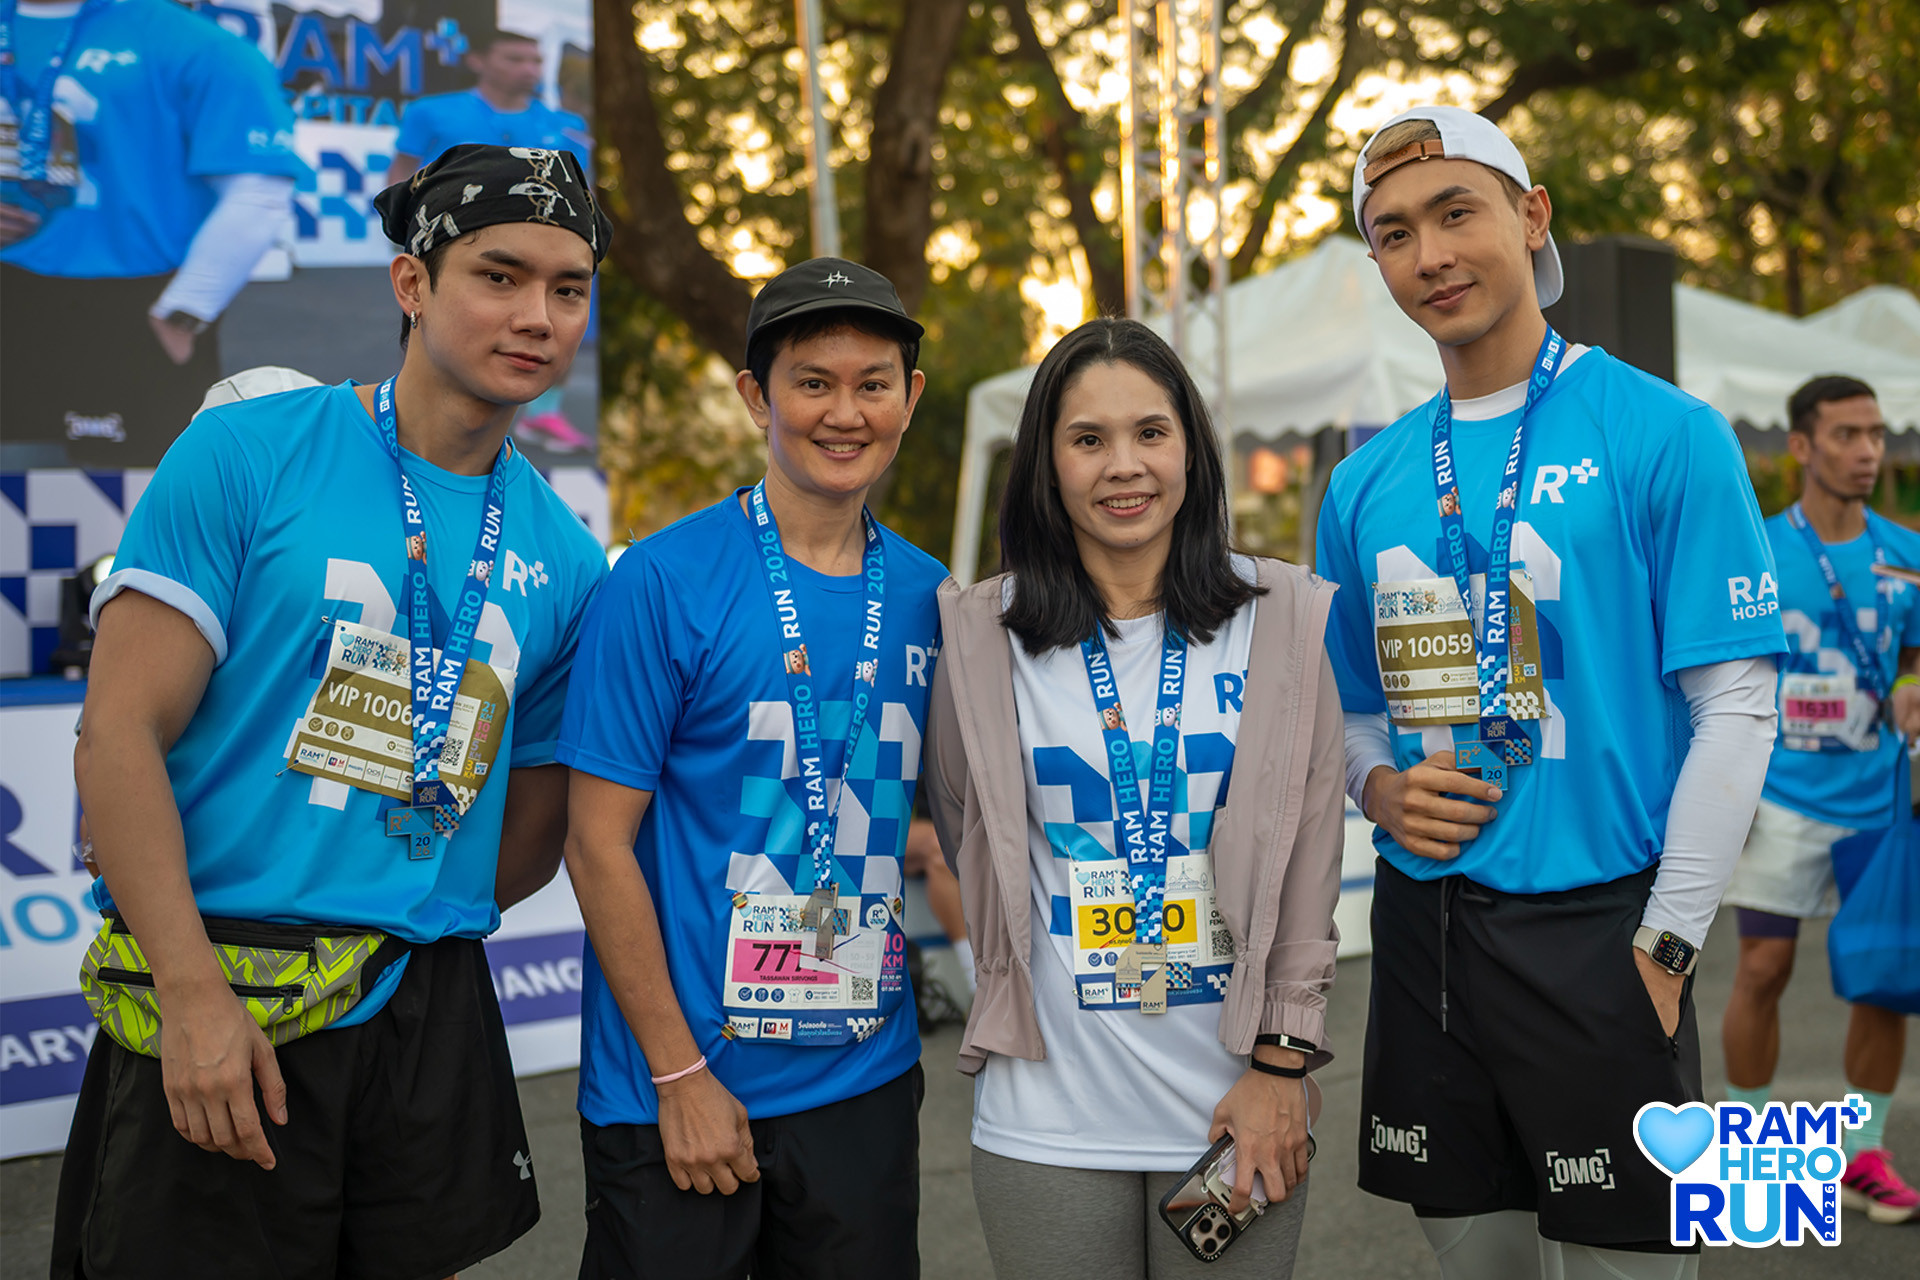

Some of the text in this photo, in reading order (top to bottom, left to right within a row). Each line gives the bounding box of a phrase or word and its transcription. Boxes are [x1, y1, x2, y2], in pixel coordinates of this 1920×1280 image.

[1434, 440, 1453, 486] RUN
[1506, 426, 1522, 475] RUN
[401, 475, 421, 524] RUN
[481, 505, 501, 551] RUN
[759, 530, 787, 583] 2026
[1447, 524, 1469, 585] HERO
[1490, 519, 1510, 582] HERO
[867, 545, 885, 594] 2026
[413, 572, 430, 638] HERO
[774, 589, 801, 639] RUN
[1379, 608, 1398, 619] RUN
[1487, 591, 1505, 643] RAM
[1510, 606, 1520, 617] 21
[449, 590, 482, 653] HERO
[864, 601, 882, 650] RUN
[1510, 626, 1521, 635] 10
[342, 649, 368, 667] RUN
[1381, 633, 1472, 658] VIP 10059
[415, 647, 431, 701] RAM
[431, 658, 462, 712] RAM
[1088, 652, 1114, 698] RUN
[1163, 649, 1182, 695] RUN
[1514, 665, 1519, 676] 3
[329, 681, 360, 708] VIP
[482, 701, 496, 714] 21
[477, 721, 490, 733] 10
[847, 693, 868, 756] HERO
[471, 740, 479, 751] 5
[794, 684, 825, 811] RAM HERO
[463, 771, 476, 780] KM
[465, 760, 473, 771] 3
[1487, 770, 1502, 779] 20
[1110, 739, 1148, 864] RAM HERO
[1148, 738, 1175, 863] RAM HERO
[416, 836, 430, 846] 20
[416, 846, 430, 856] 26
[1091, 871, 1114, 879] RAM
[1084, 886, 1115, 898] RUN
[753, 906, 774, 914] RAM
[1092, 904, 1185, 936] 300
[743, 920, 774, 933] RUN
[885, 933, 904, 952] 10
[883, 955, 903, 967] KM
[1554, 1156, 1606, 1185] OMG
